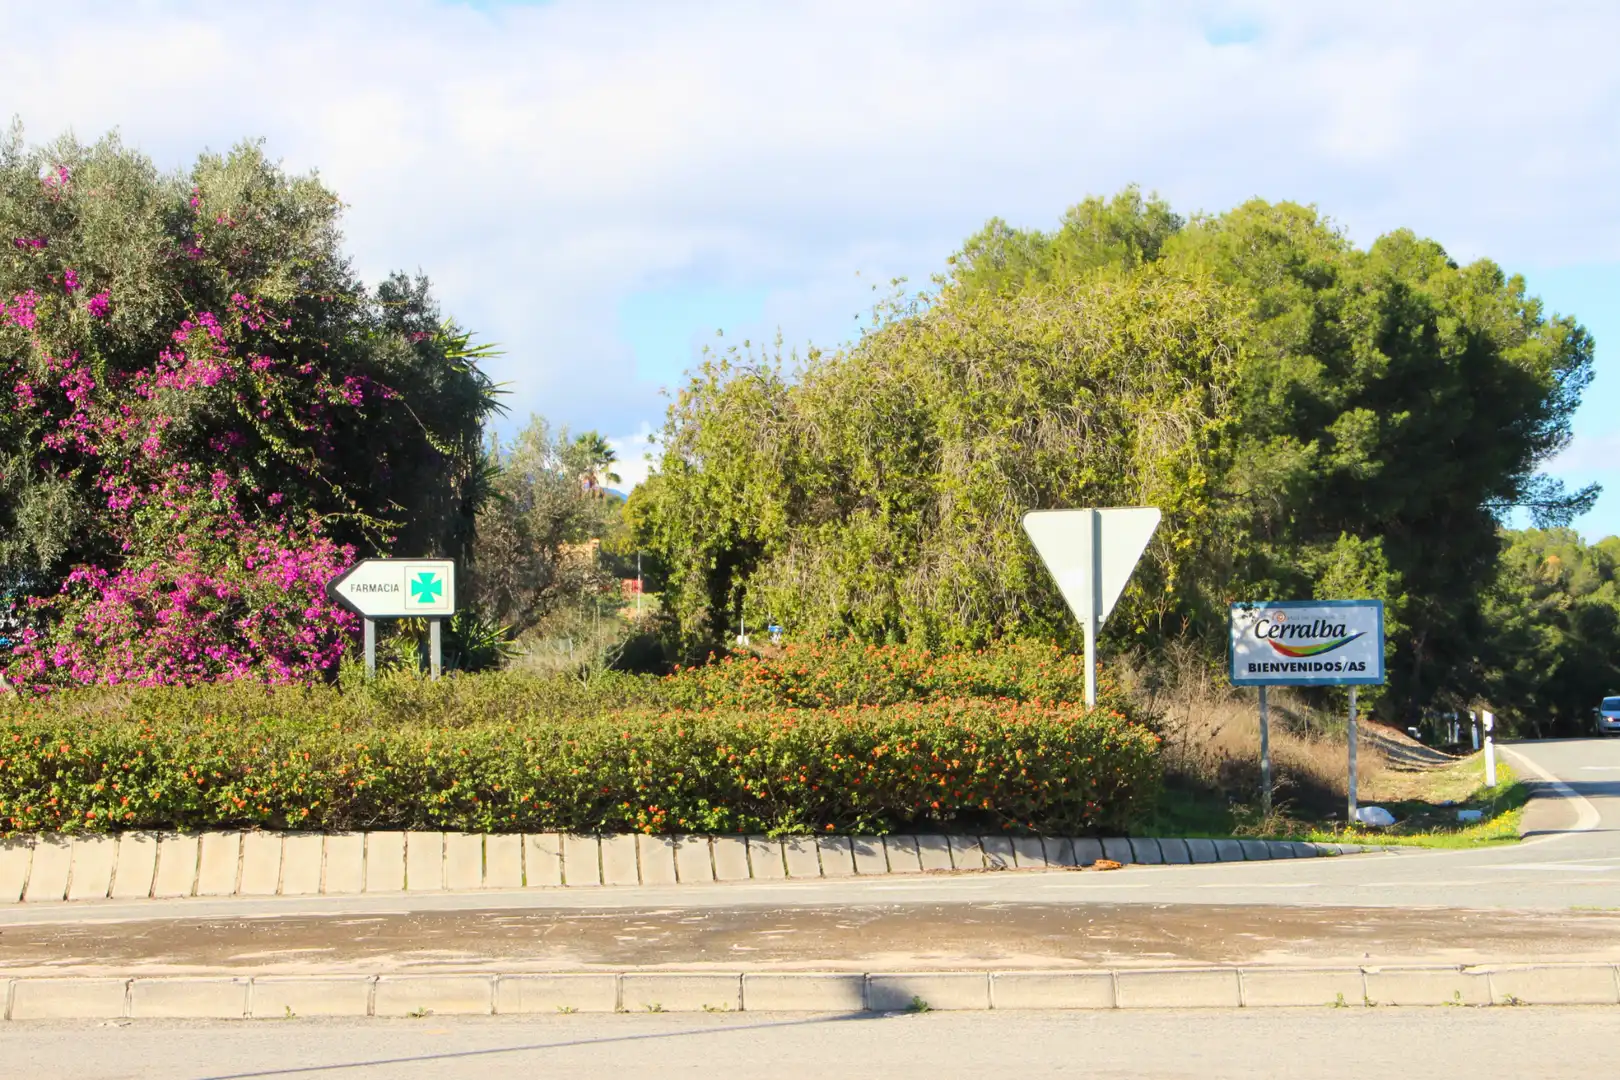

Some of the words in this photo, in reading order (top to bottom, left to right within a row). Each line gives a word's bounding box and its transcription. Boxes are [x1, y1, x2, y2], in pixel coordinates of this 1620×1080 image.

[350, 583, 400, 593] FARMACIA
[1254, 619, 1347, 639] Cerralba
[1248, 661, 1366, 673] BIENVENIDOS/AS
